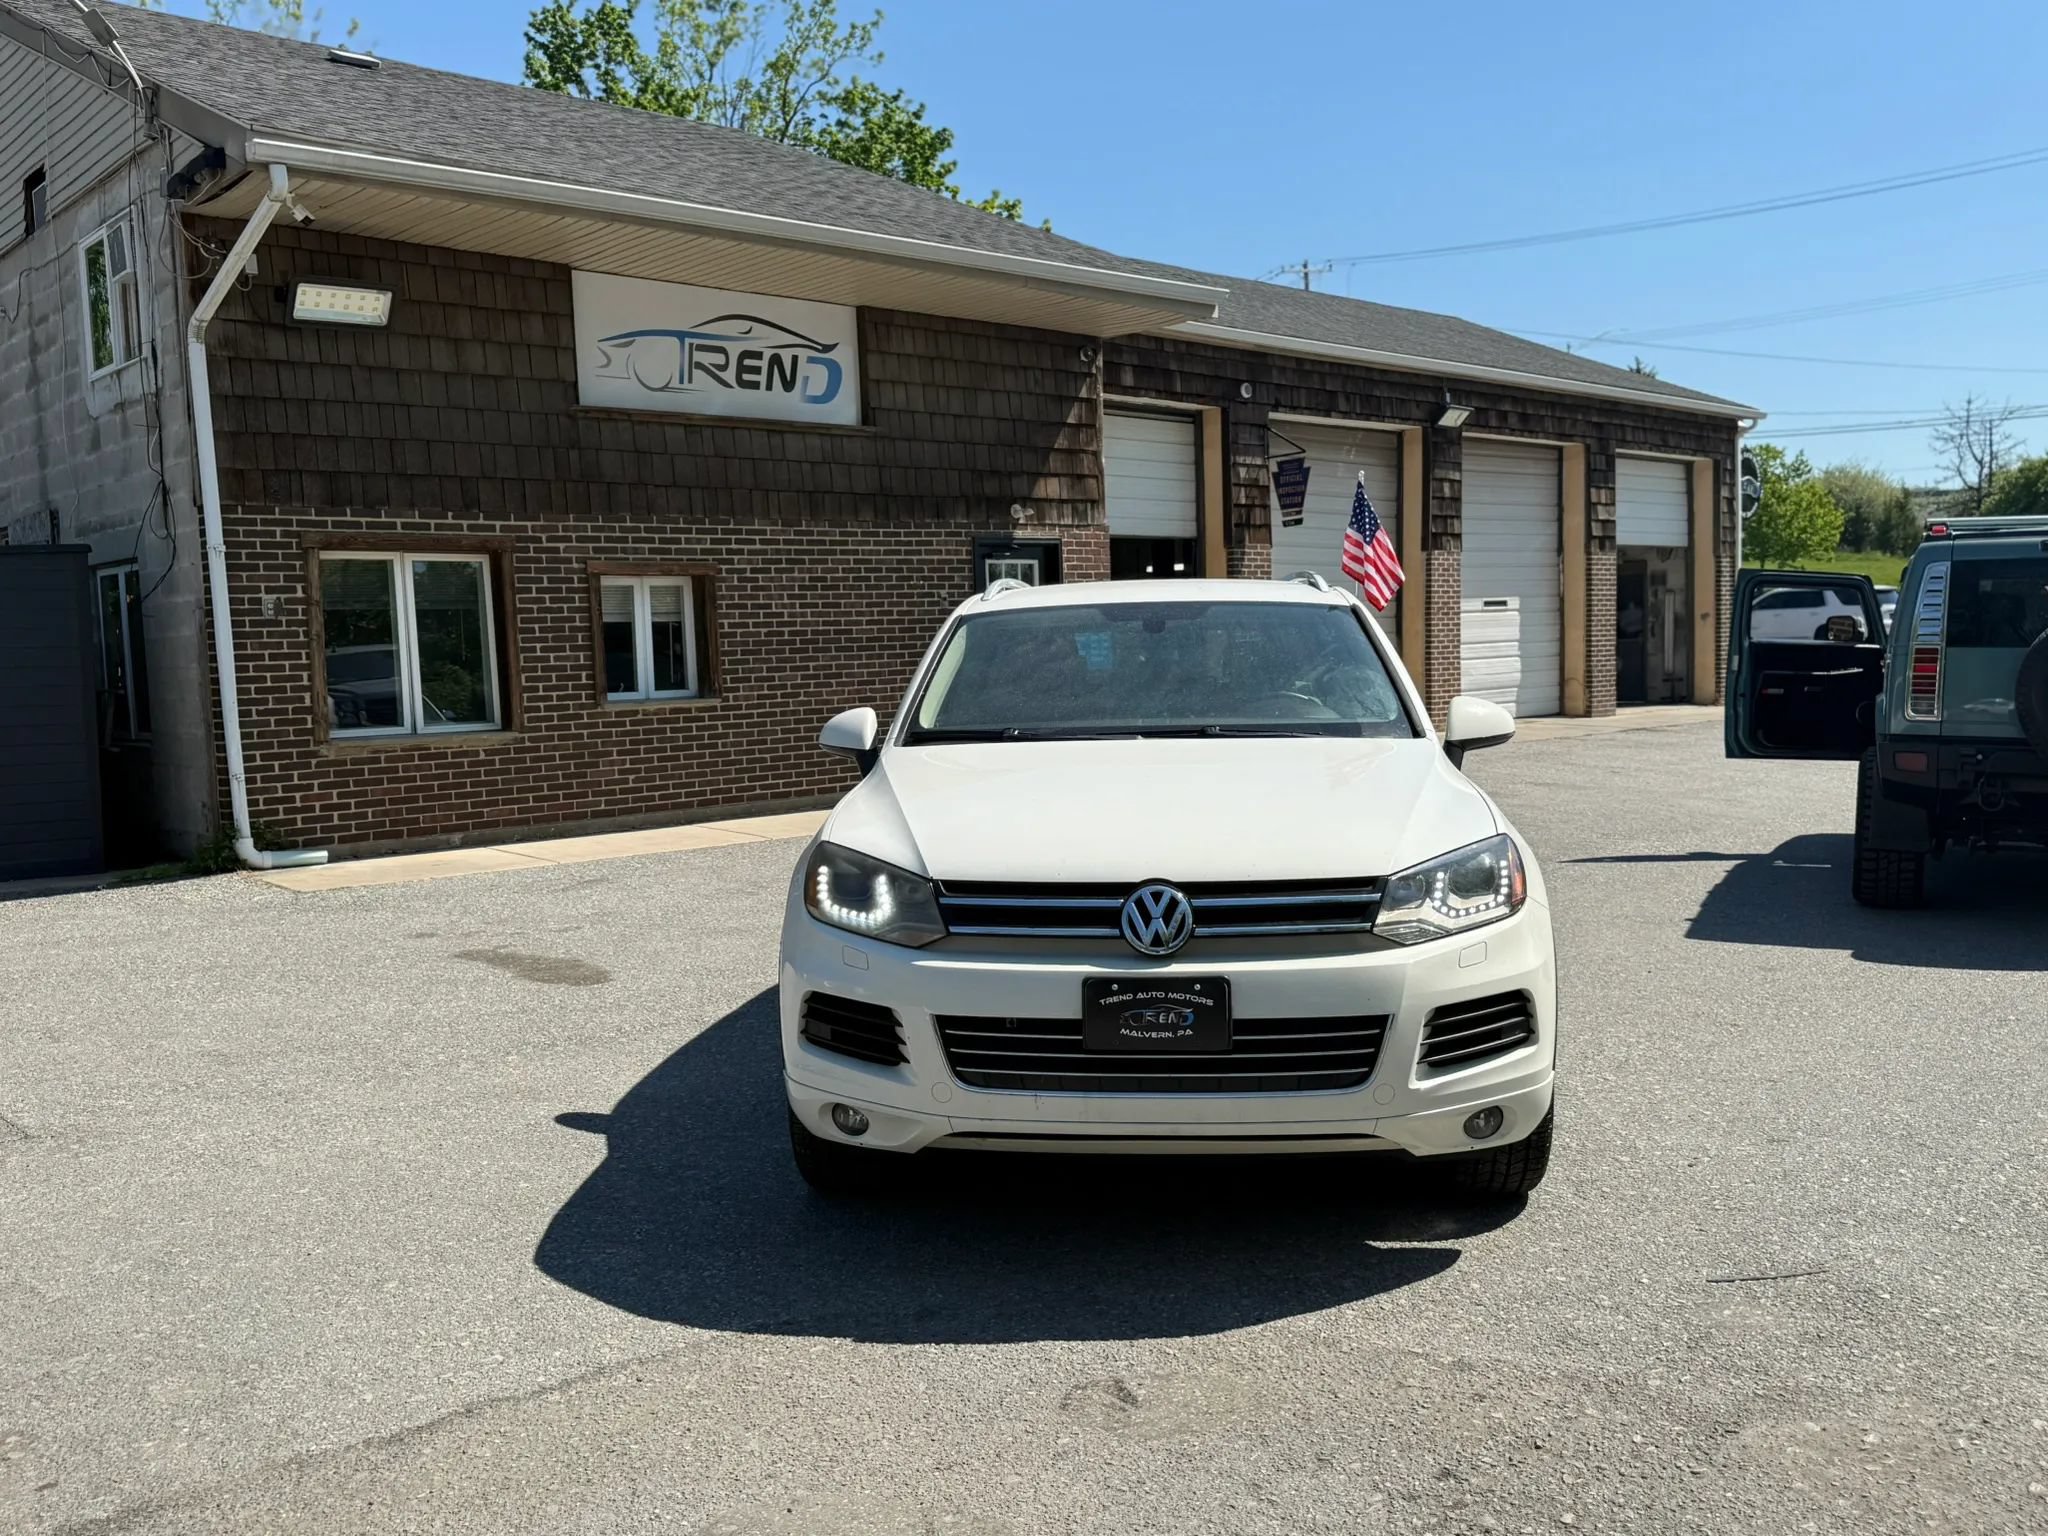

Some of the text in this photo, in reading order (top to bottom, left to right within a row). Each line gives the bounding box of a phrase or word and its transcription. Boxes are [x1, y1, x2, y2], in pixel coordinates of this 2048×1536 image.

[645, 328, 843, 404] TREND
[1099, 991, 1214, 1006] TREND AUTO MOTORS
[1177, 1028, 1194, 1037] PA
